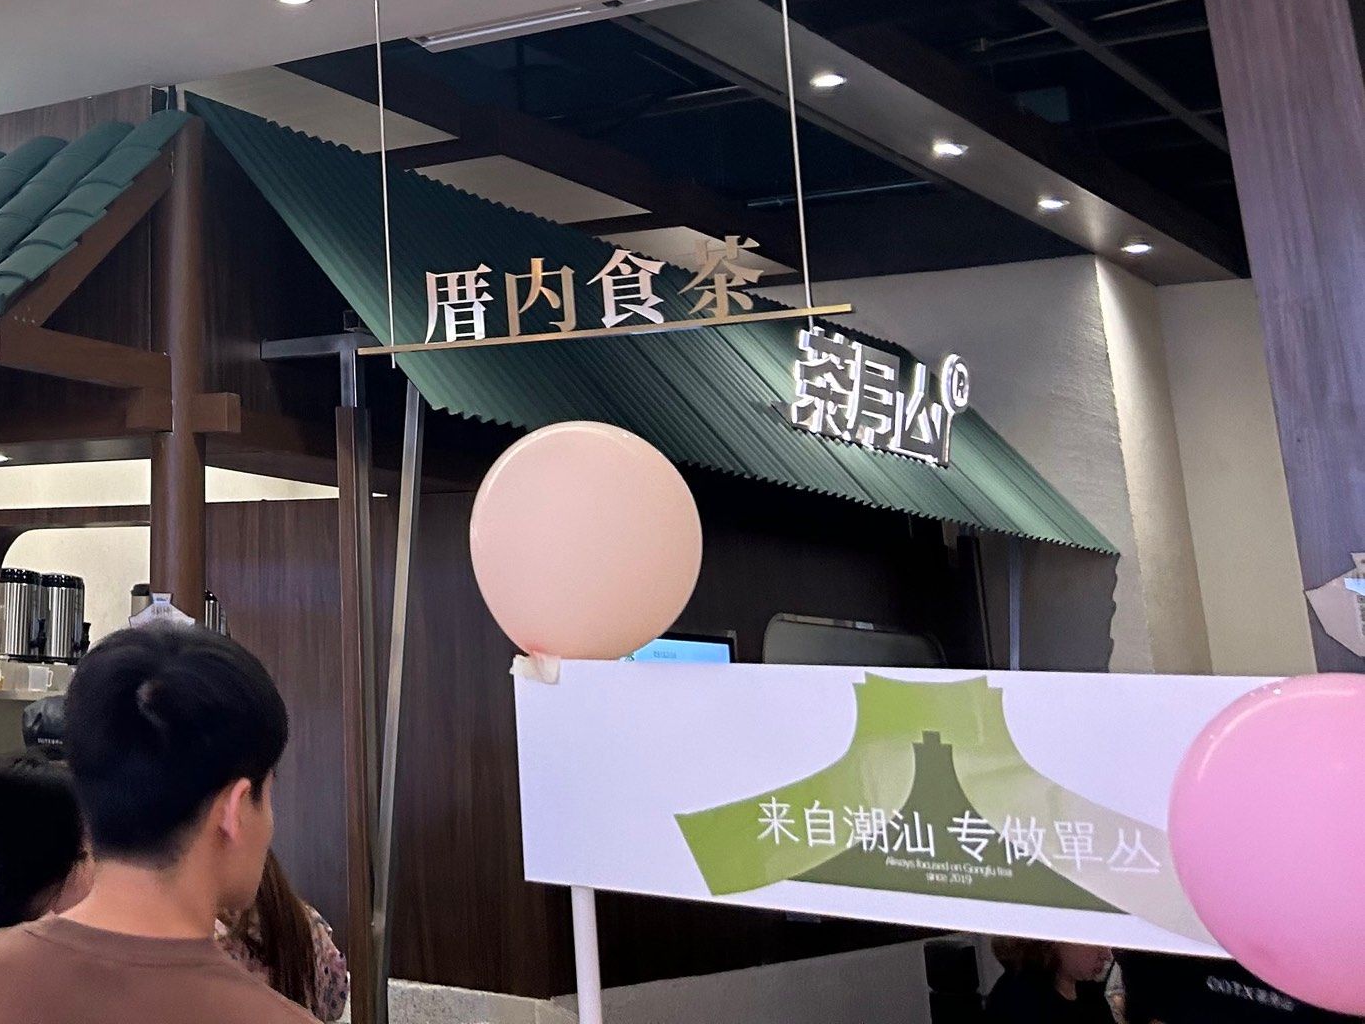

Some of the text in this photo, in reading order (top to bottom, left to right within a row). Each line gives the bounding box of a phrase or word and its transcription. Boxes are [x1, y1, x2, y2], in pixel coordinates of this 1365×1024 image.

[424, 236, 764, 344] 厝内食茶
[757, 796, 1161, 873] 来自潮汕 专做單丛
[885, 856, 915, 870] Always
[949, 872, 973, 885] 2019
